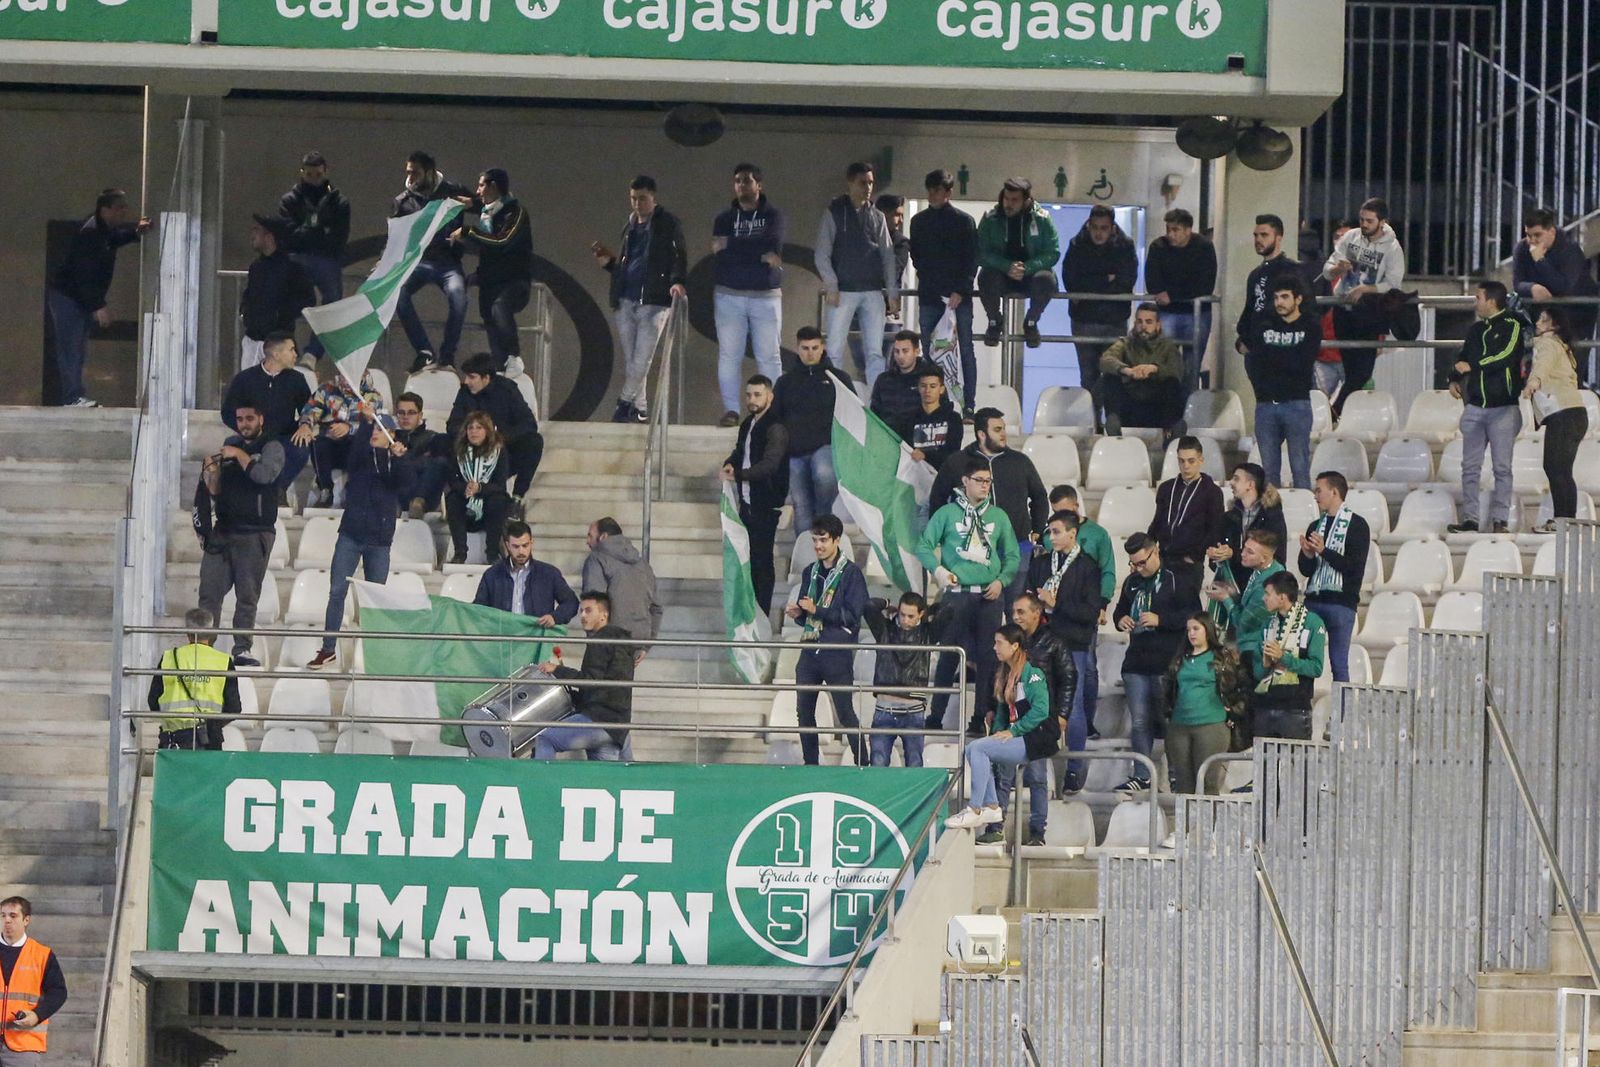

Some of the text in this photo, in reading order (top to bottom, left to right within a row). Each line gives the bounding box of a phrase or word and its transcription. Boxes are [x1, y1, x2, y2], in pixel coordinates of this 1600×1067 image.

[603, 0, 833, 42] cajasur
[937, 0, 1168, 50] cajasur
[223, 778, 675, 864] GRADA DE
[759, 868, 889, 893] Grada de Animación
[178, 875, 714, 966] ANIMACIÓN
